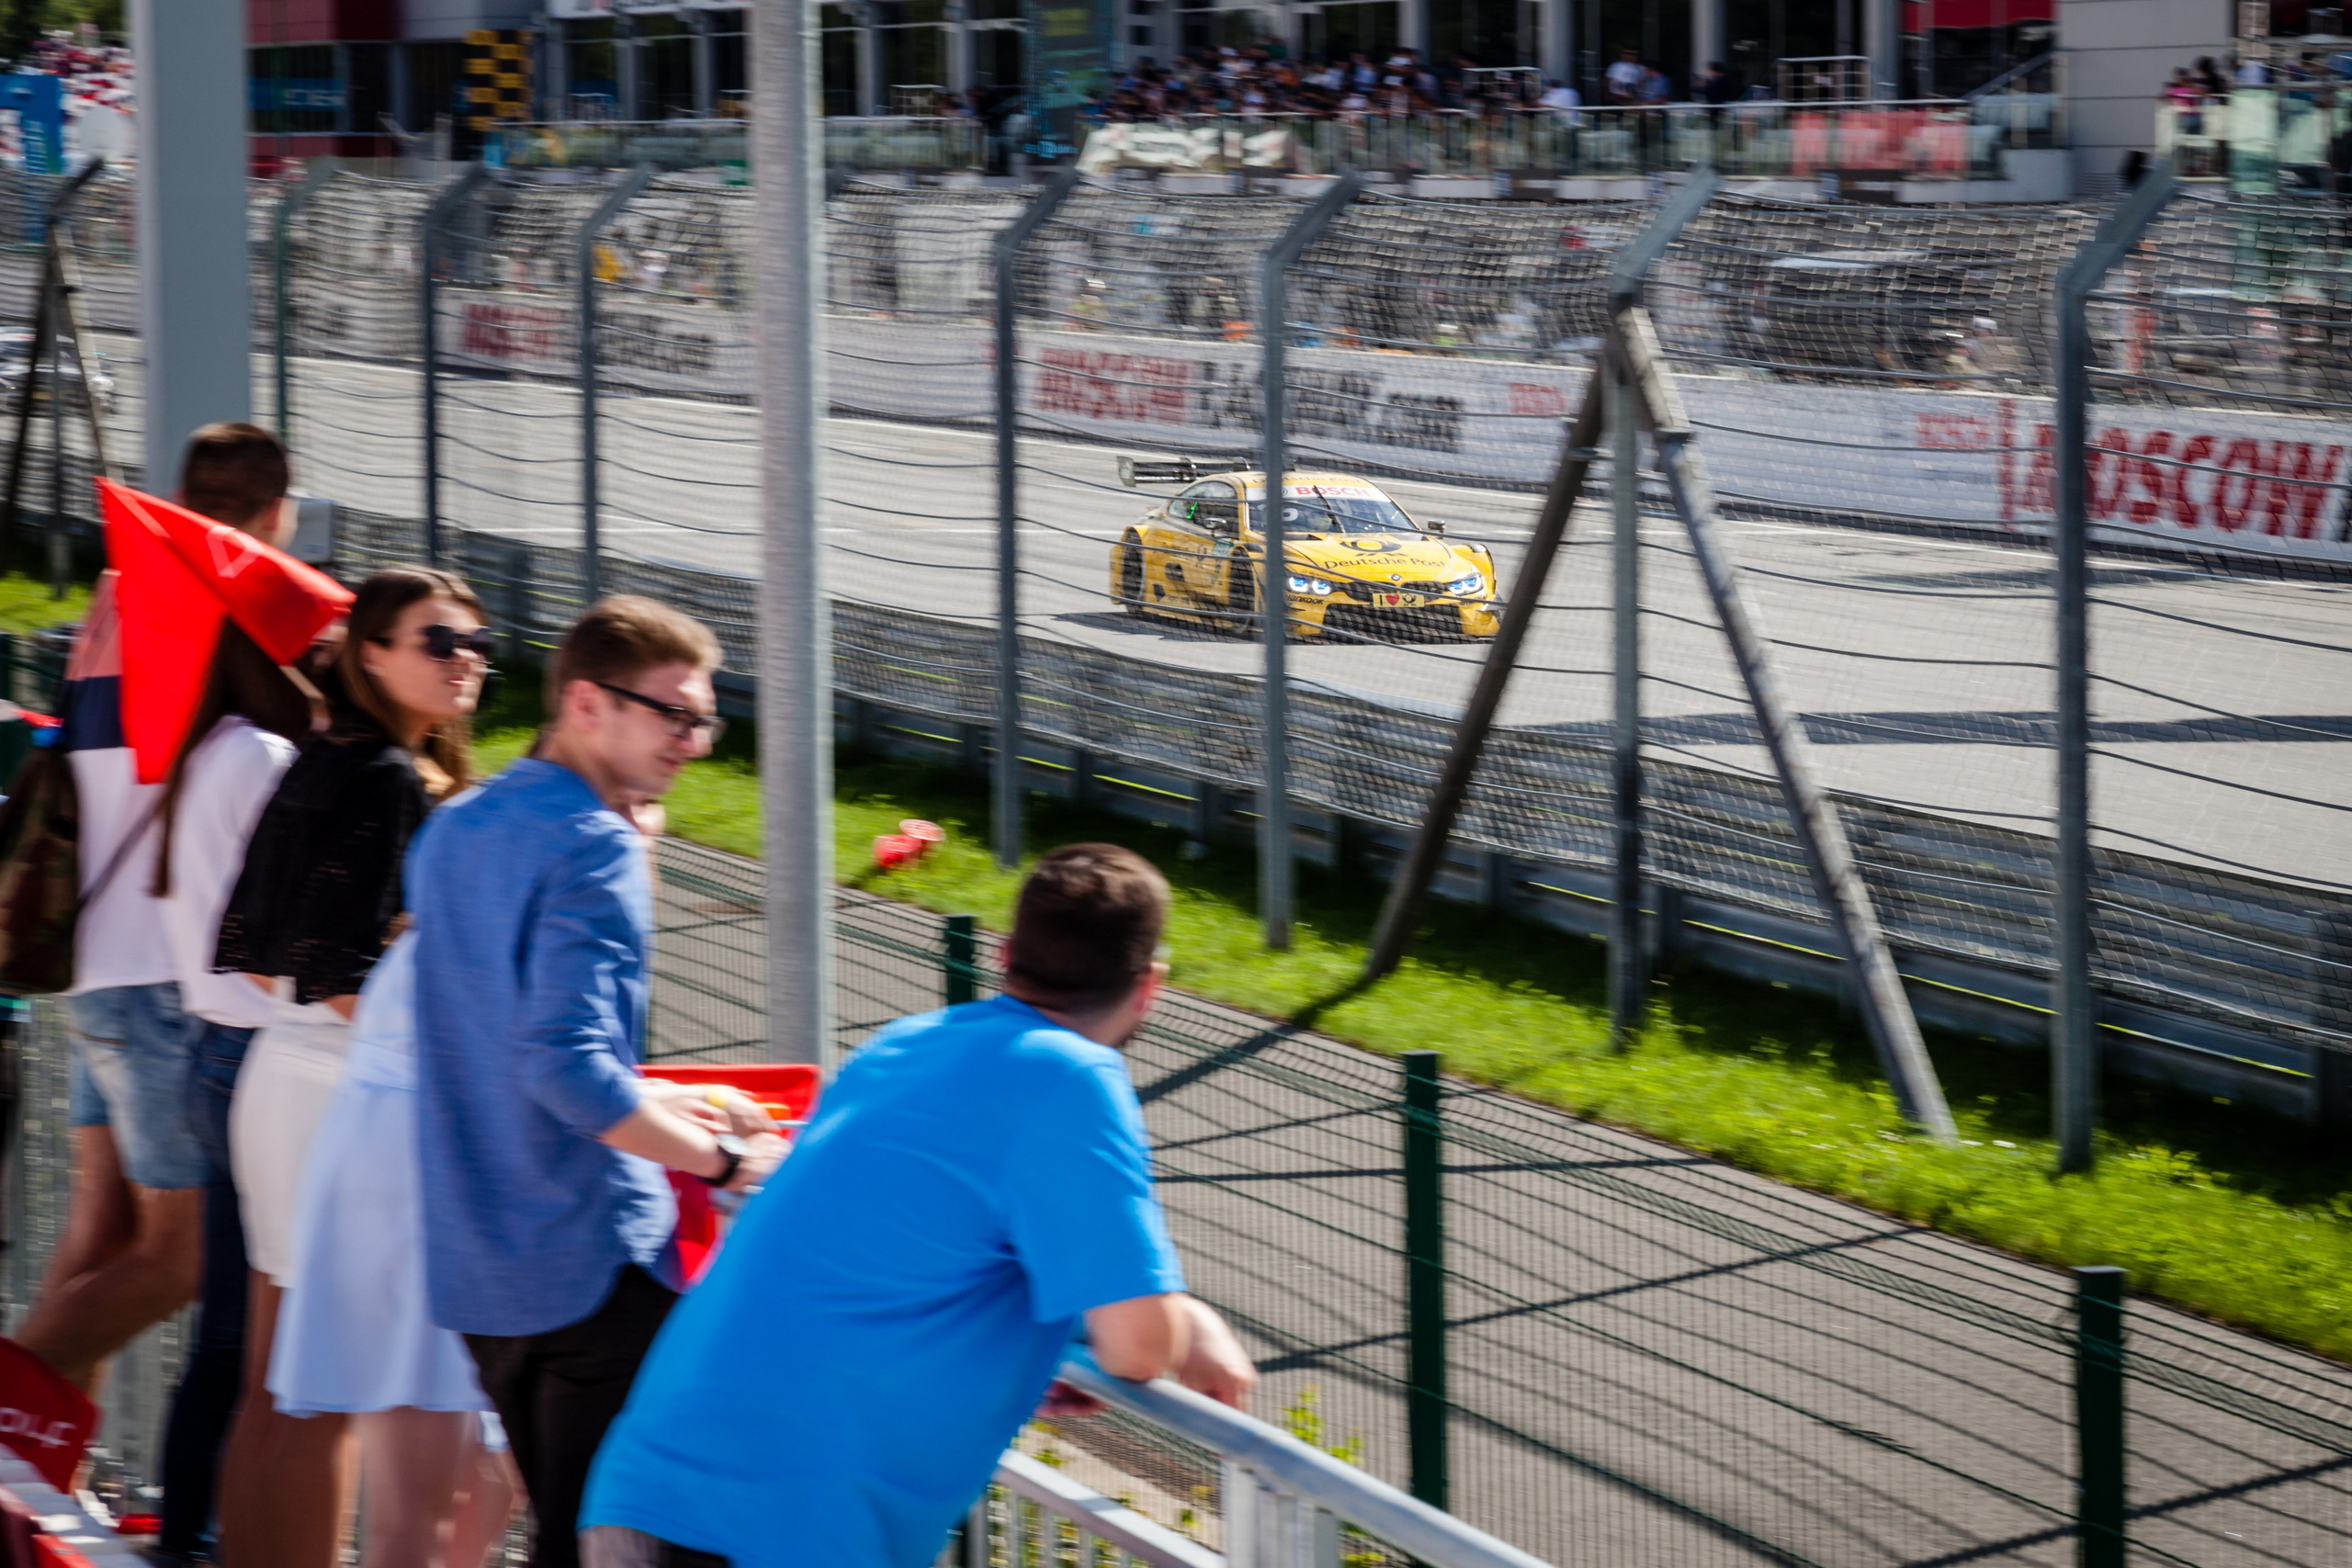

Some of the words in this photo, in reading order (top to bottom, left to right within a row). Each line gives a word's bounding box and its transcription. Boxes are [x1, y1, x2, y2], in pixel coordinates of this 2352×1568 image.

[1295, 486, 1371, 497] BOSCH
[1324, 557, 1407, 569] Deutsche
[1410, 558, 1449, 568] Post
